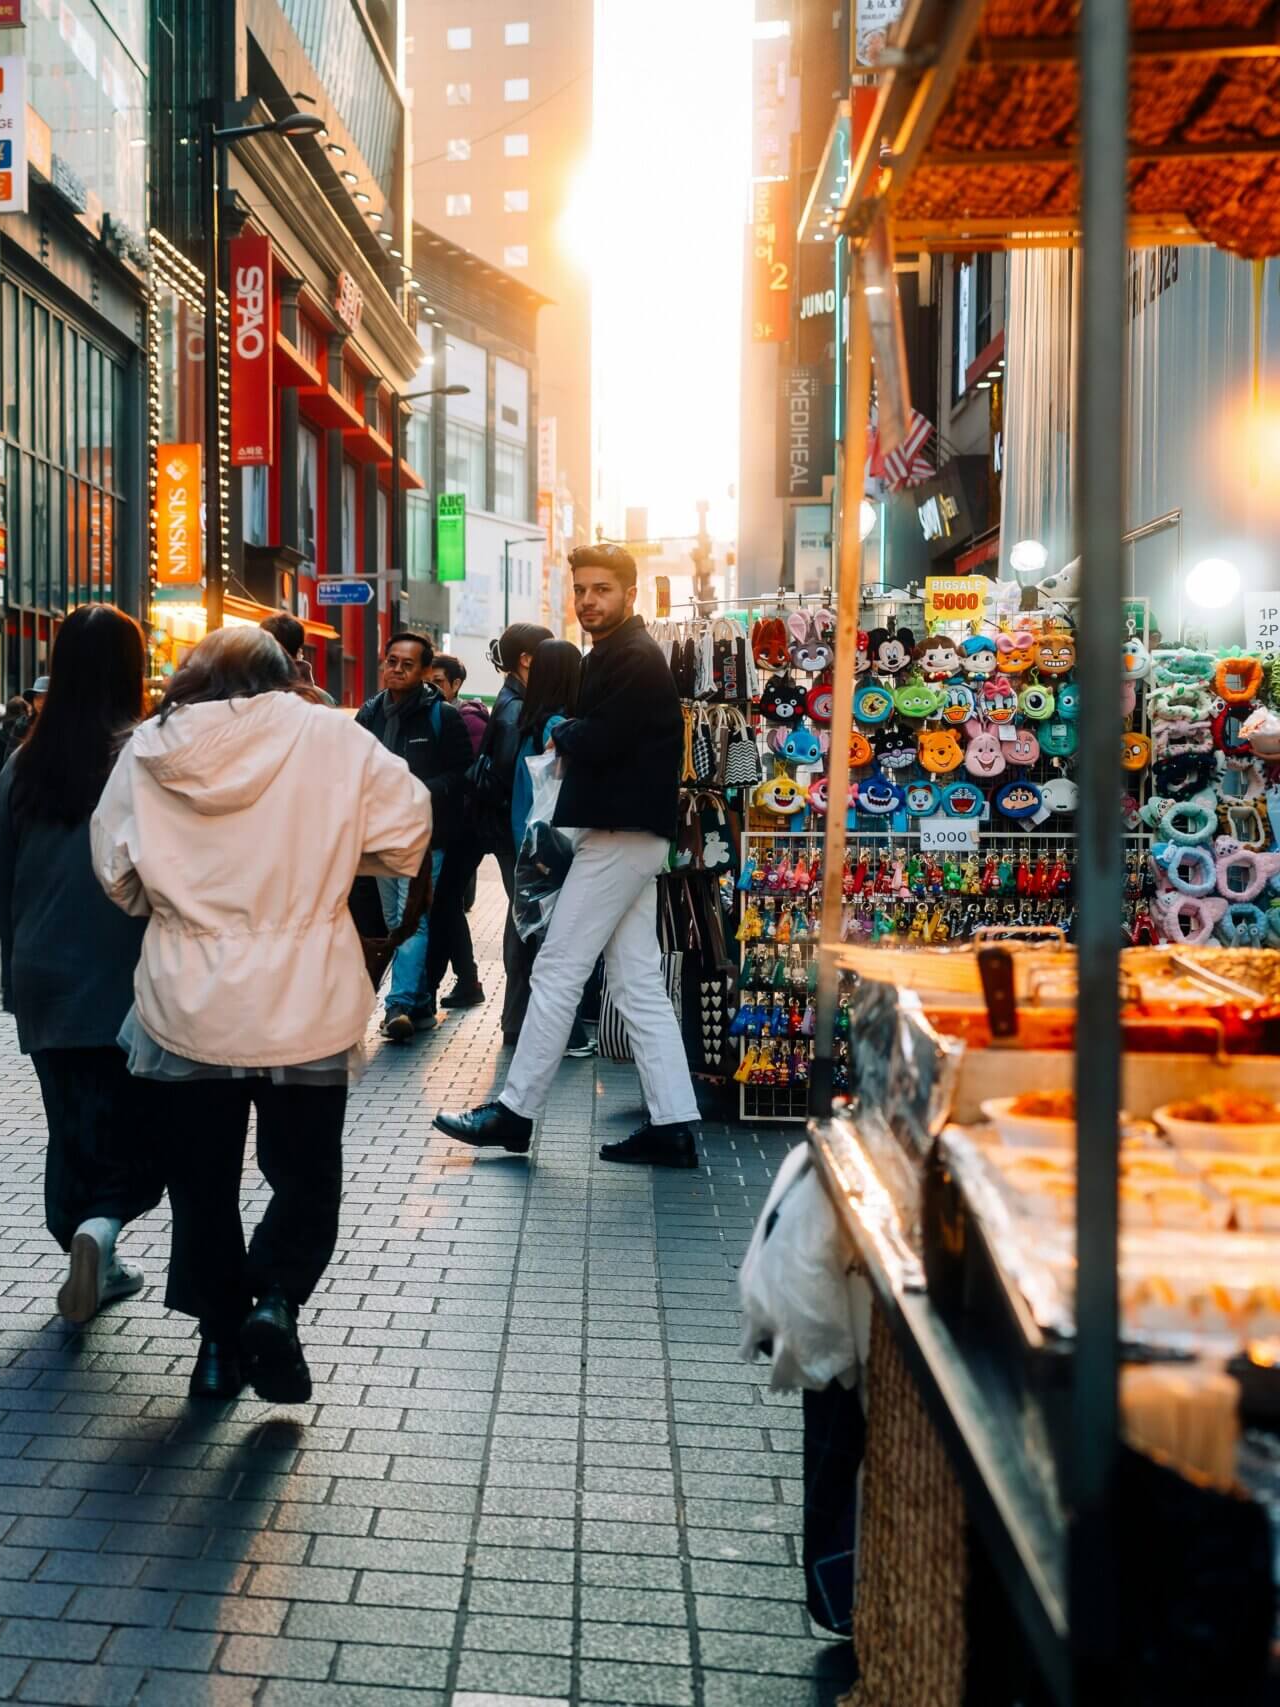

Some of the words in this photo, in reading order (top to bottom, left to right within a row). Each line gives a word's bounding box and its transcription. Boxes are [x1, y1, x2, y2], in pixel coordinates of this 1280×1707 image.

[770, 263, 789, 291] 2
[236, 266, 265, 360] SPAO
[800, 289, 835, 320] JUNO
[789, 378, 810, 492] MEDIHEAL
[439, 495, 463, 508] ABC
[168, 487, 188, 575] SUNSKIN
[933, 592, 979, 611] 5000
[1259, 607, 1278, 620] 1P
[1258, 624, 1279, 636] 2P
[923, 831, 968, 845] 3,000
